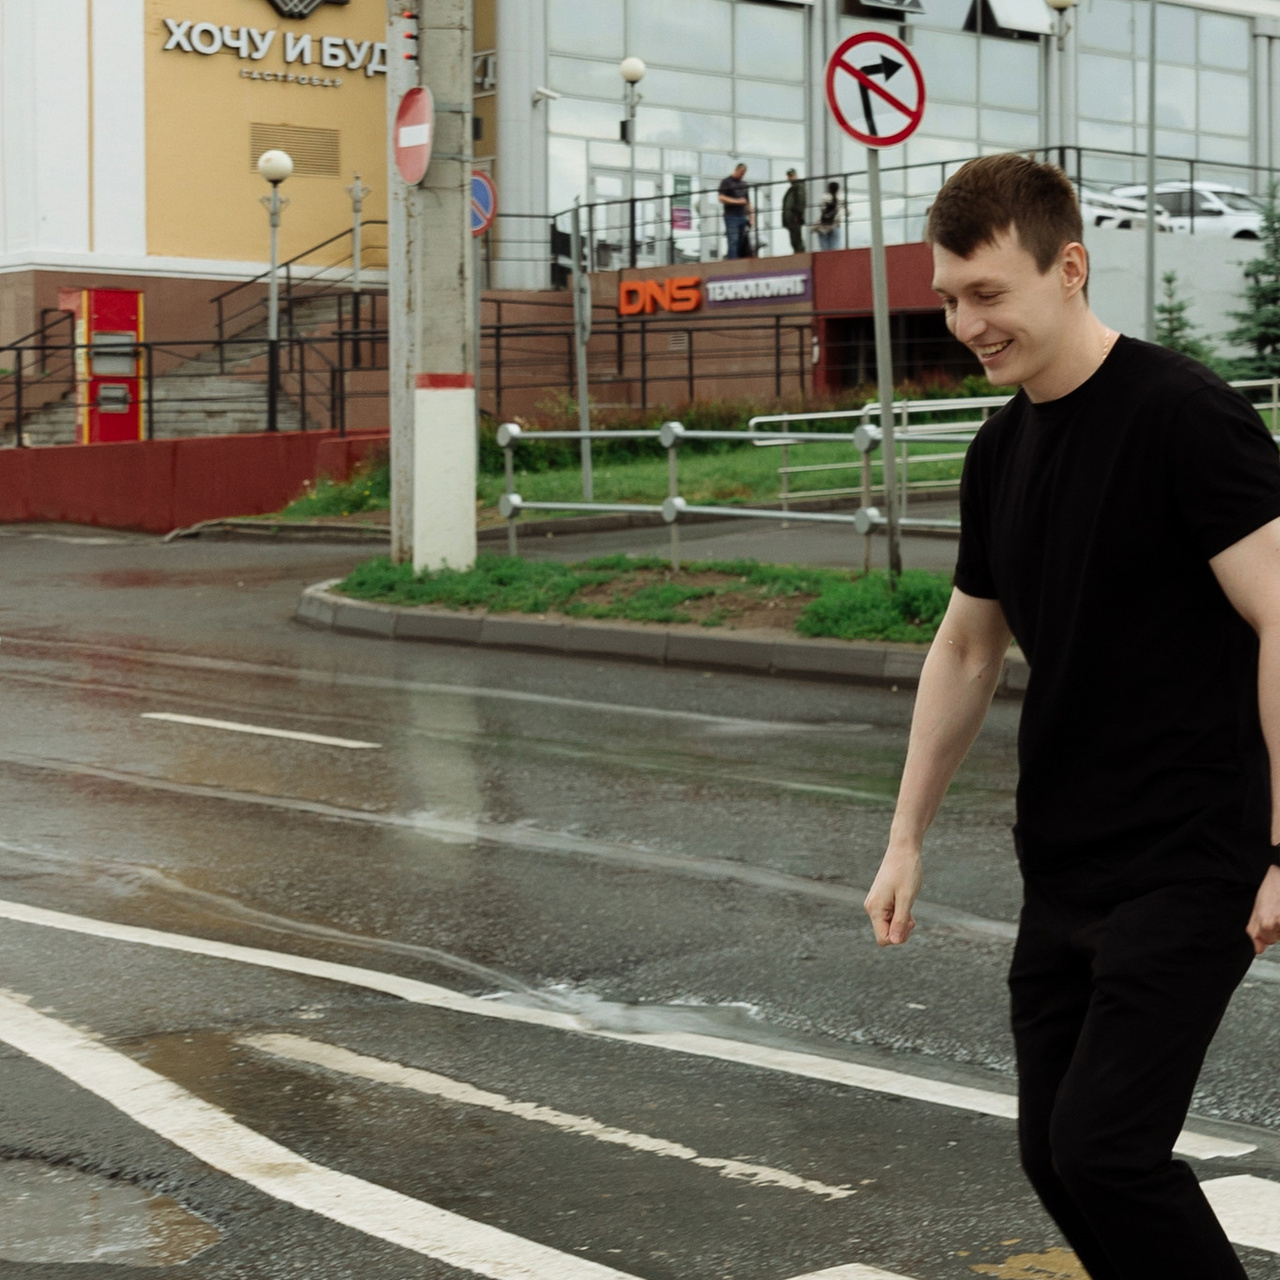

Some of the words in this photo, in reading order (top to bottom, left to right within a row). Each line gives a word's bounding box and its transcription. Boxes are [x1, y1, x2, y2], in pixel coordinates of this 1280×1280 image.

[163, 18, 276, 60] ХОЧУ
[284, 32, 312, 65] И
[240, 69, 343, 88] ГАСТРОБАР
[618, 276, 702, 316] DNS
